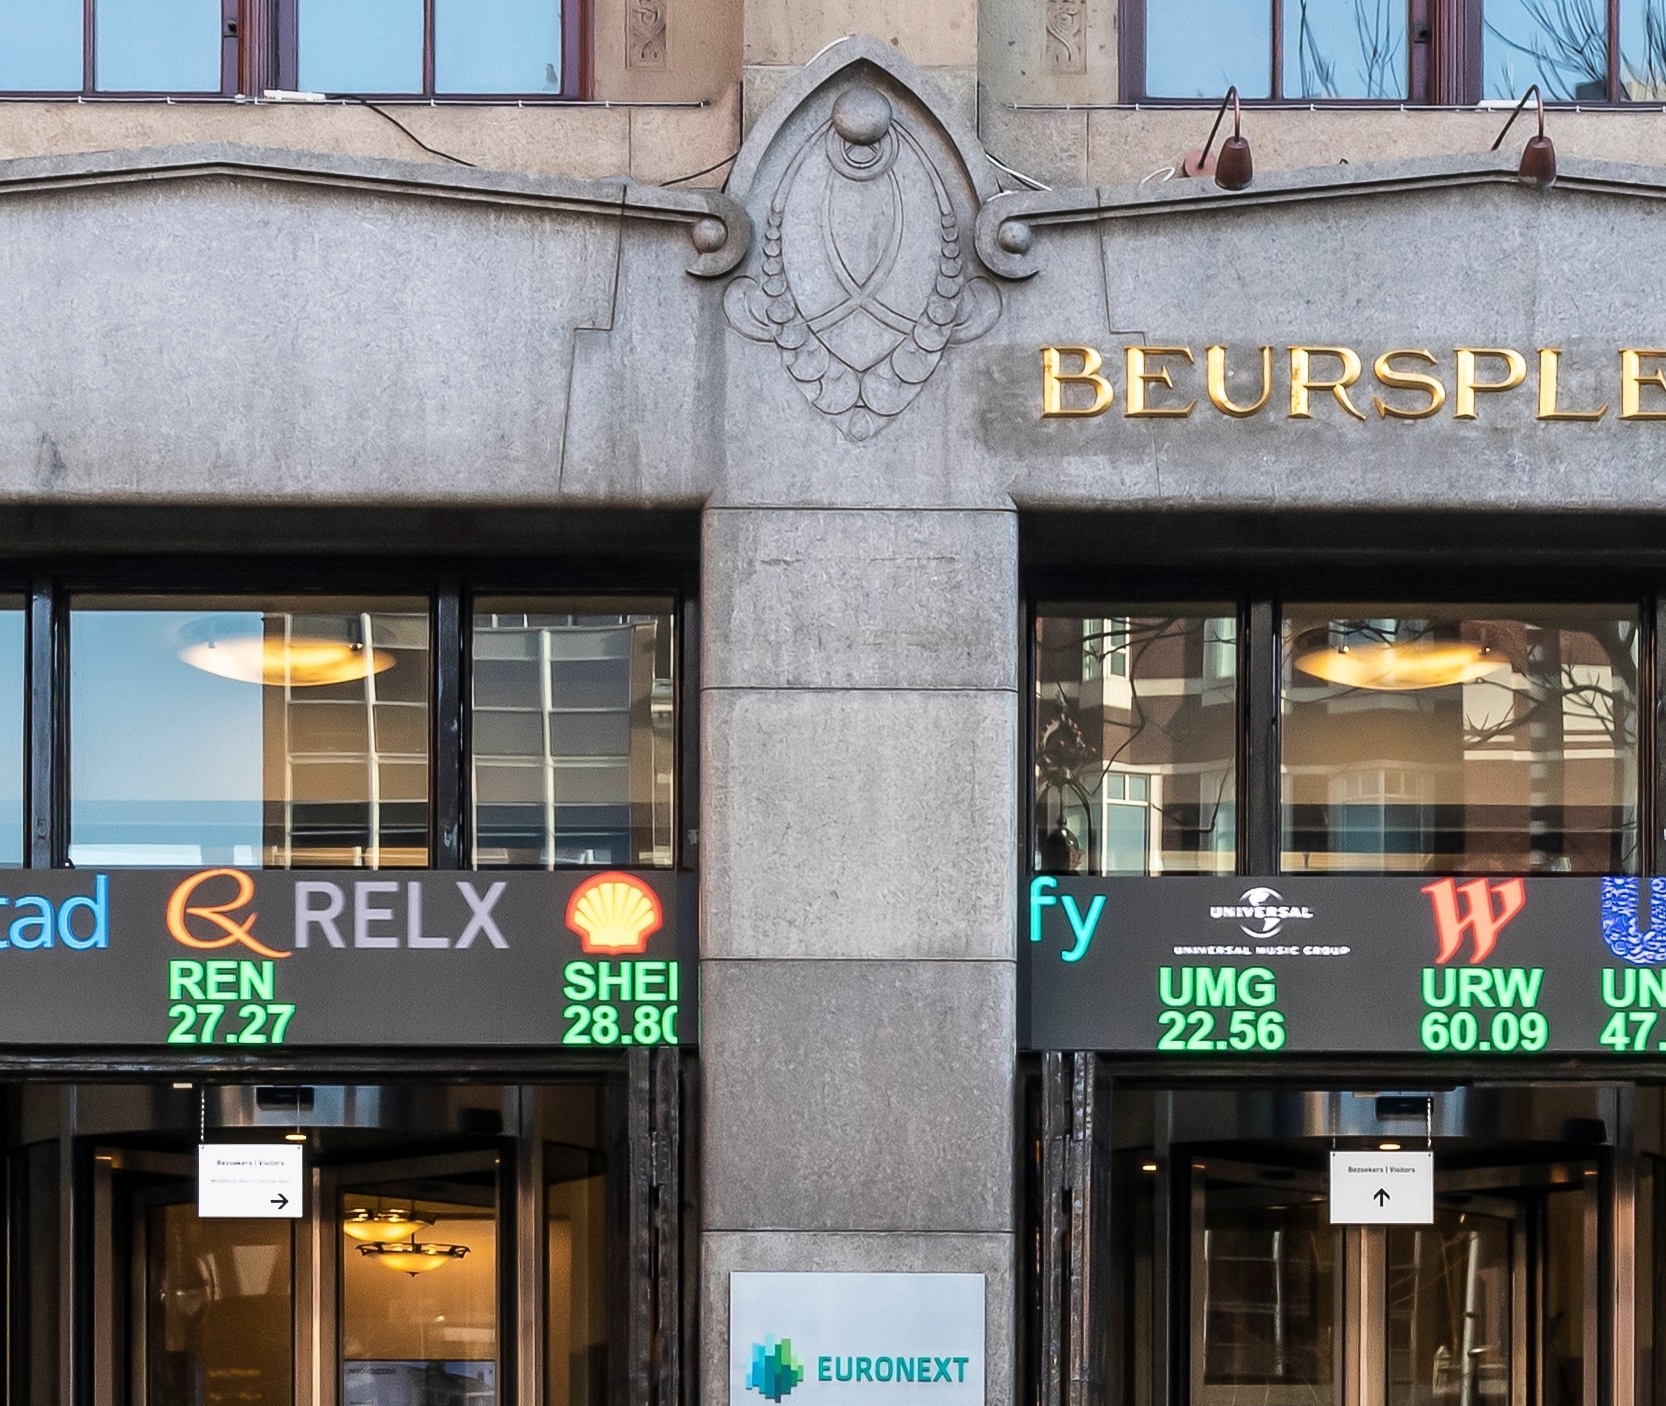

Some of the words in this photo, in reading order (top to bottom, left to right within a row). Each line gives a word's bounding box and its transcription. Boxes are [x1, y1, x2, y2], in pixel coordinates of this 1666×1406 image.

[294, 881, 510, 949] RELX
[1030, 876, 1106, 962] fy
[1210, 905, 1314, 920] UNIVERSAL
[1173, 946, 1252, 956] UNIVERSAL
[1255, 946, 1300, 956] MUSIC
[1303, 946, 1351, 956] GROUP
[169, 961, 274, 1001] REN
[1159, 967, 1276, 1007] UMG
[1422, 968, 1544, 1008] URW
[167, 1004, 295, 1044] 27.27
[1157, 1011, 1286, 1050] 22.56
[1421, 1012, 1548, 1052] 60.09
[817, 1356, 970, 1383] EURONEXT
